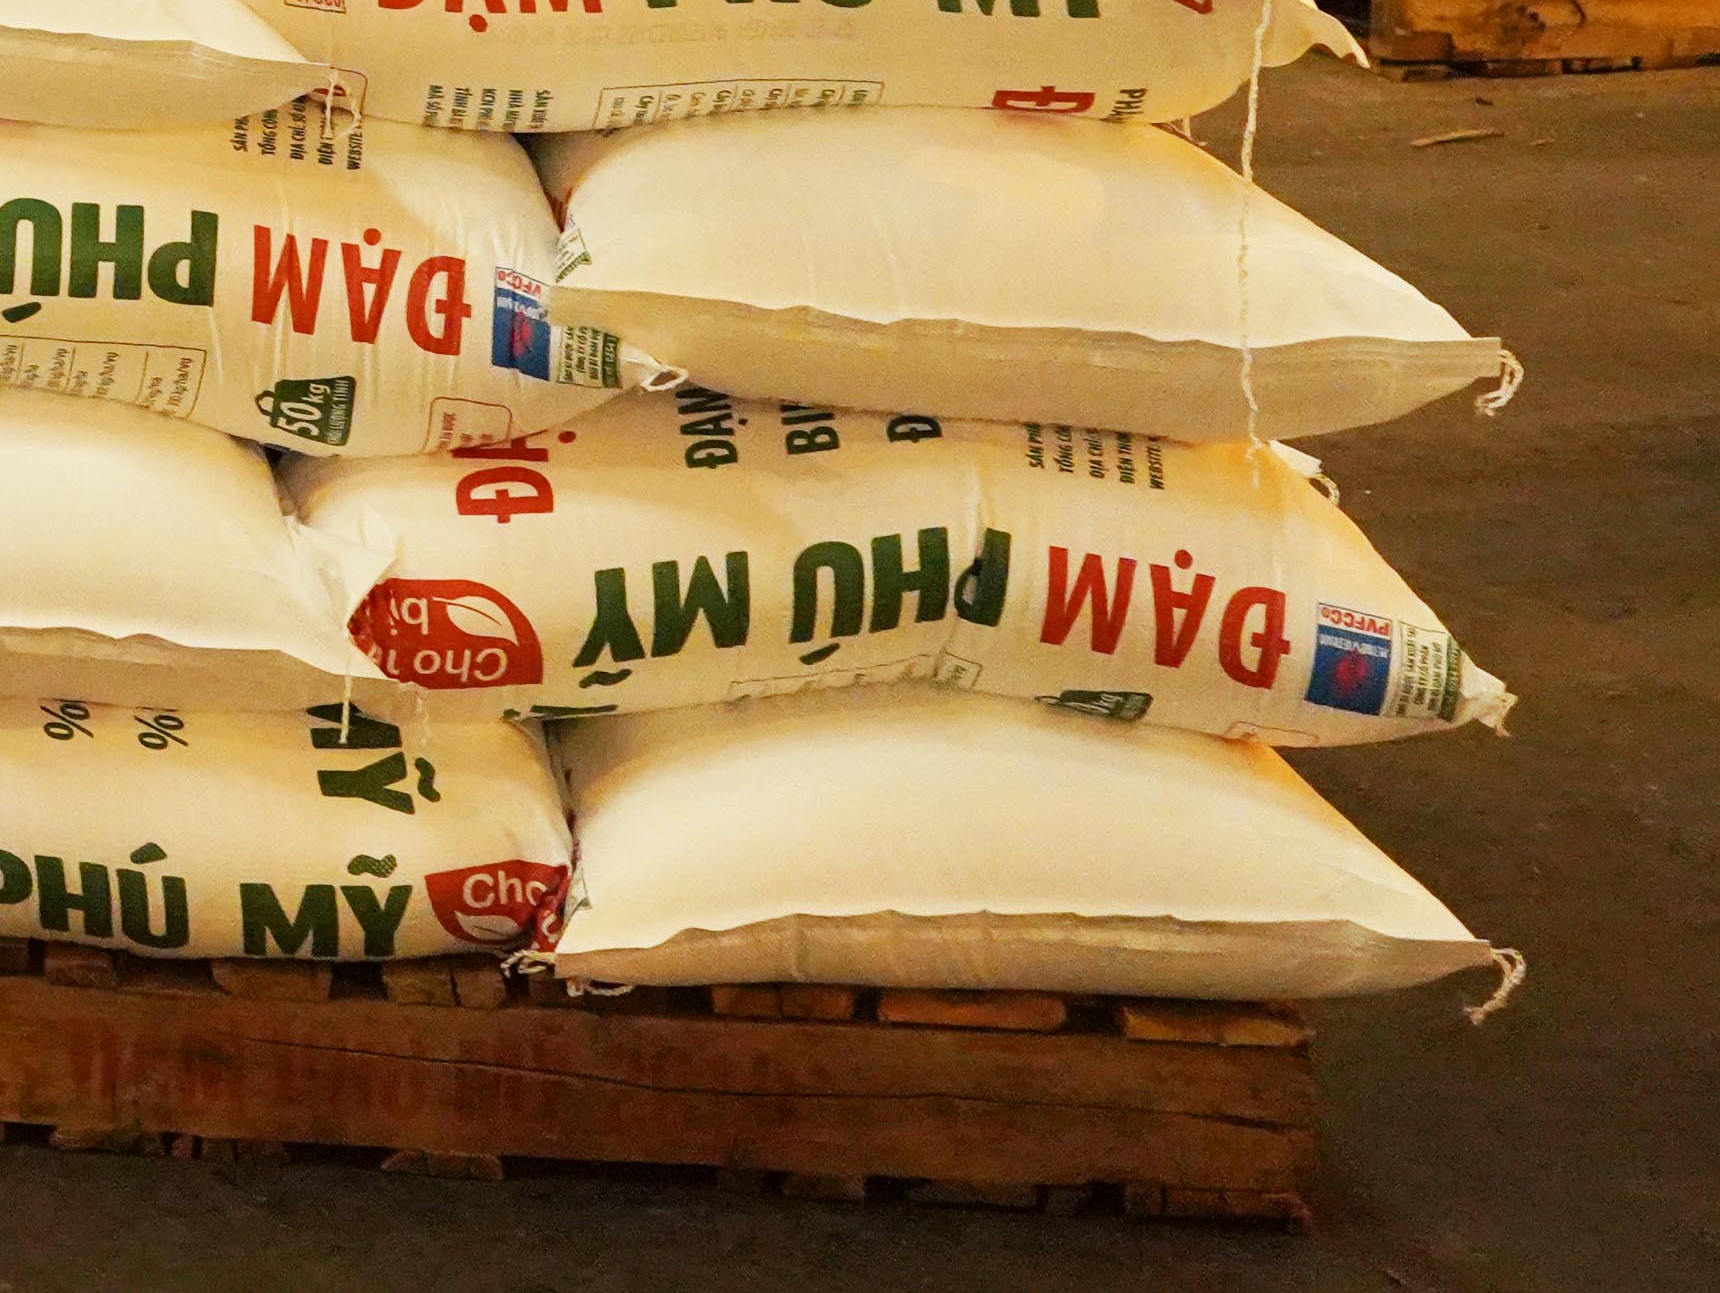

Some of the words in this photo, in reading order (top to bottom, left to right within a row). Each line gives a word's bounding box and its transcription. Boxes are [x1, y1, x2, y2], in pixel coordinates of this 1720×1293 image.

[250, 225, 472, 357] ĐẠM
[276, 400, 323, 437] 50
[301, 383, 331, 404] kg
[571, 551, 751, 689] MỸ
[789, 527, 1011, 665] PHÚ
[1039, 546, 1291, 691] ĐẠM
[413, 647, 509, 682] Cho
[42, 696, 95, 743] %
[137, 709, 190, 752] %
[236, 854, 417, 961] MỸ
